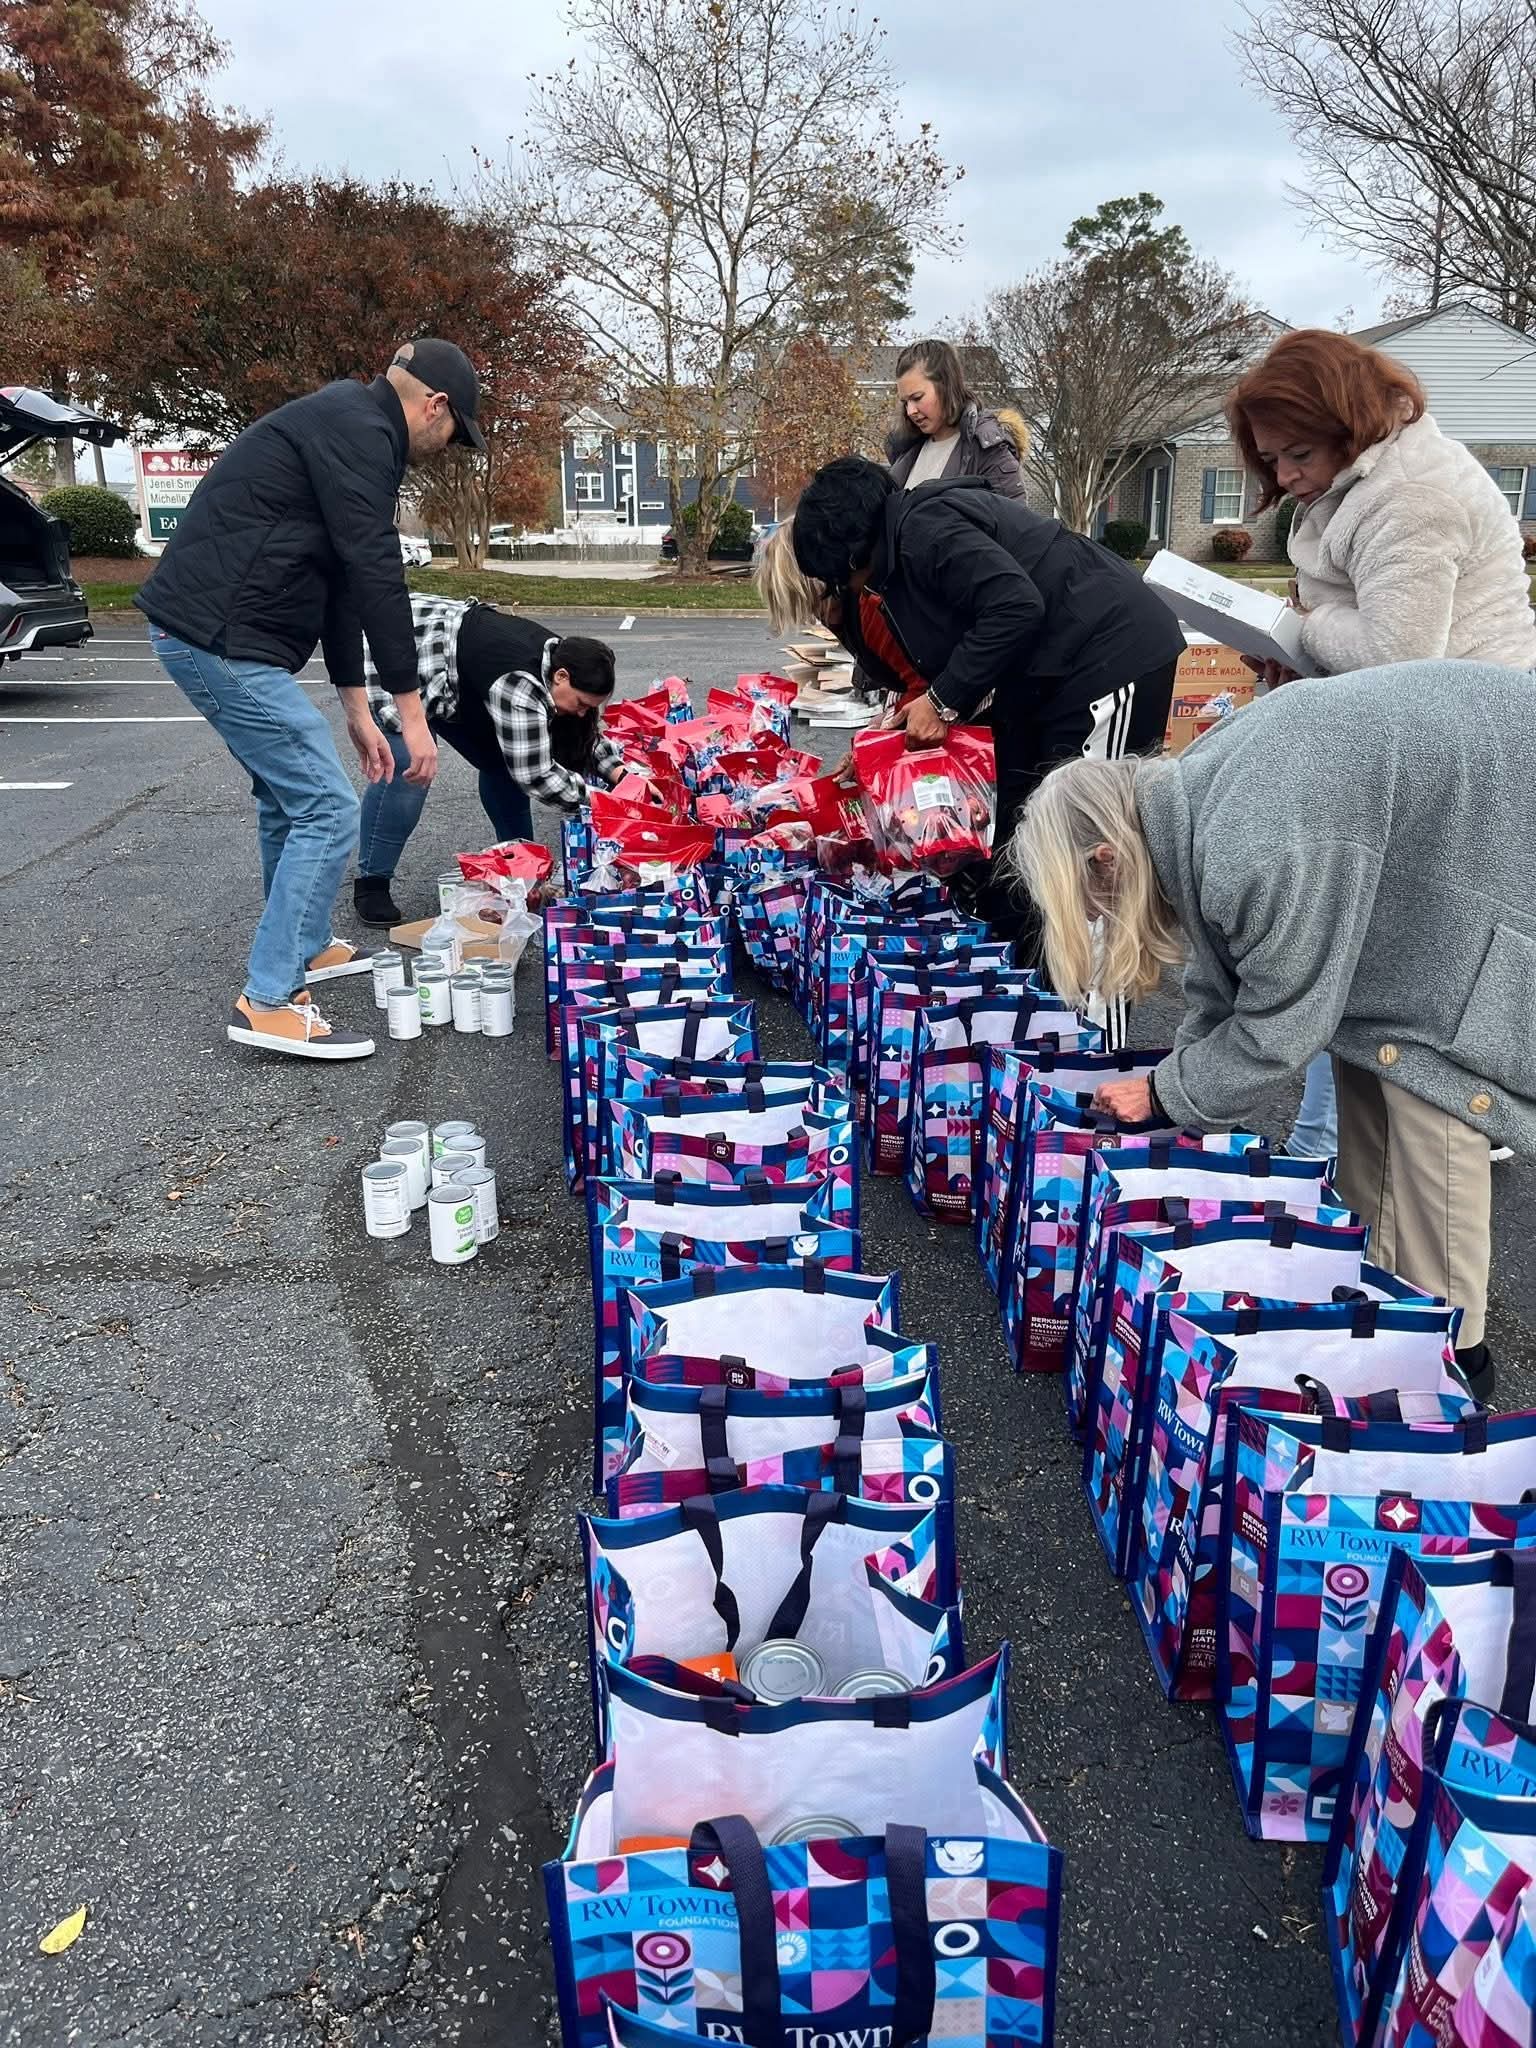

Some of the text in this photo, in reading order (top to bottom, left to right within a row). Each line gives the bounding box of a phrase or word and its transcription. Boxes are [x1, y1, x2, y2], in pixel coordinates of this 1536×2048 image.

[150, 493, 187, 504] Michelle
[1179, 667, 1205, 676] GOTTA
[1206, 667, 1218, 676] BE
[609, 1251, 638, 1267] RW
[1157, 1397, 1176, 1425] RW
[1290, 1528, 1330, 1549] RW
[1460, 1747, 1513, 1786] RW
[582, 1893, 738, 1923] RW Towne
[658, 1915, 739, 1930] FOUNDATION
[784, 2024, 894, 2048] Town
